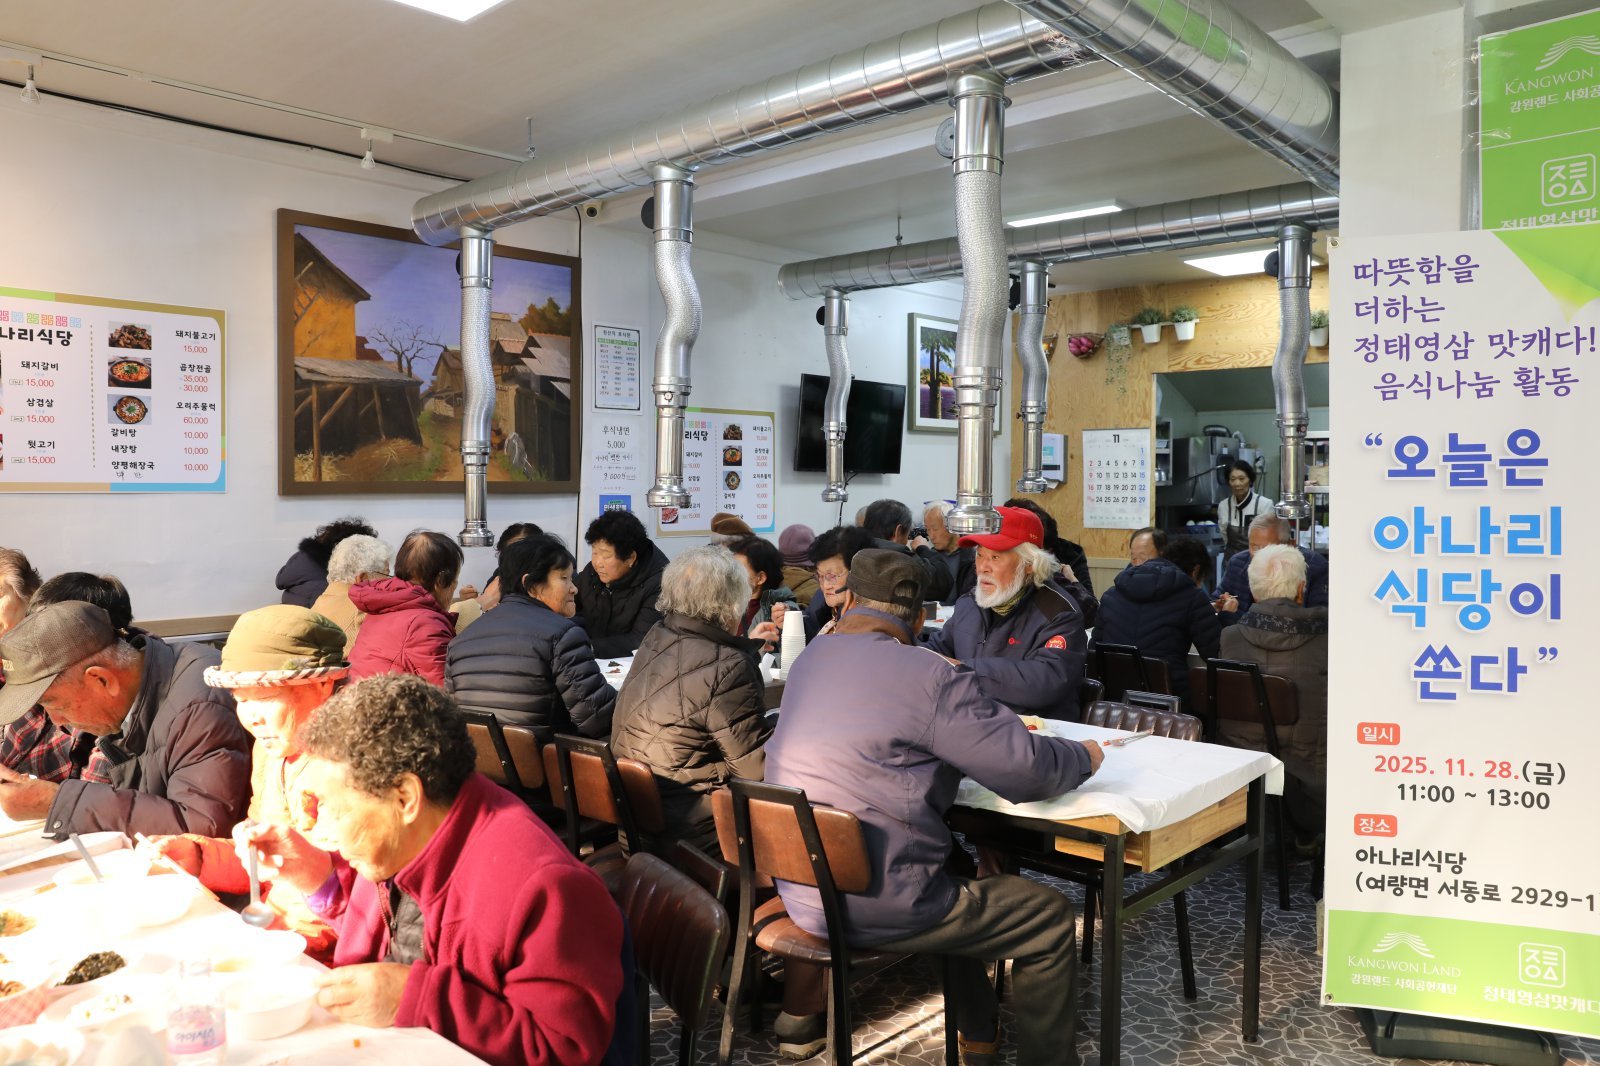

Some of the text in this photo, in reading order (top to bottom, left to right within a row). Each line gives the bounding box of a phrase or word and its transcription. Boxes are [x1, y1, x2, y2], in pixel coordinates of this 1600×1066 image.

[1505, 66, 1594, 96] KANGWON
[1510, 93, 1559, 113] 강원랜드
[1353, 253, 1480, 288] 따뜻함을
[1354, 294, 1446, 325] 더하는
[175, 330, 216, 341] 돼지불고기
[183, 345, 208, 354] 15,000
[1353, 325, 1597, 363] 정태영삼 맛캐다!
[21, 360, 59, 371] 돼지갈비
[179, 363, 212, 374] 곱창전골
[25, 378, 55, 388] 15,000
[183, 375, 209, 383] 35,000
[1373, 366, 1580, 402] 음식나눔 활동
[183, 384, 209, 393] 30,000
[26, 398, 54, 408] 삼겹살
[175, 401, 217, 412] 오리주물럭
[26, 414, 55, 424] 15,000
[183, 416, 209, 425] 60,000
[111, 428, 209, 440] 갈비탕 10,000
[602, 425, 630, 436] 후식냉면
[27, 439, 55, 450] 뒷고기
[1112, 434, 1120, 444] 11
[111, 444, 209, 455] 내장탕 10,000
[27, 456, 56, 465] 15,000
[1364, 428, 1549, 487] “오늘은
[111, 461, 209, 472] 양평해장국 10,000
[1373, 506, 1562, 556] 아나리
[1373, 568, 1561, 631] 식당이
[1413, 643, 1559, 701] 쏜다”
[1361, 725, 1395, 744] 일시
[1374, 754, 1435, 775] 2025.
[1445, 758, 1474, 777] 11.
[1397, 783, 1455, 803] 11:00
[1486, 788, 1550, 810] 13:00
[1358, 816, 1392, 835] 장소
[1355, 846, 1467, 875] 아나리식당
[1355, 871, 1600, 915] (여량면 서동로 2929-1
[1347, 955, 1461, 978] KANGWON LAND
[1351, 973, 1457, 995] 강원랜드 사회공헌재단
